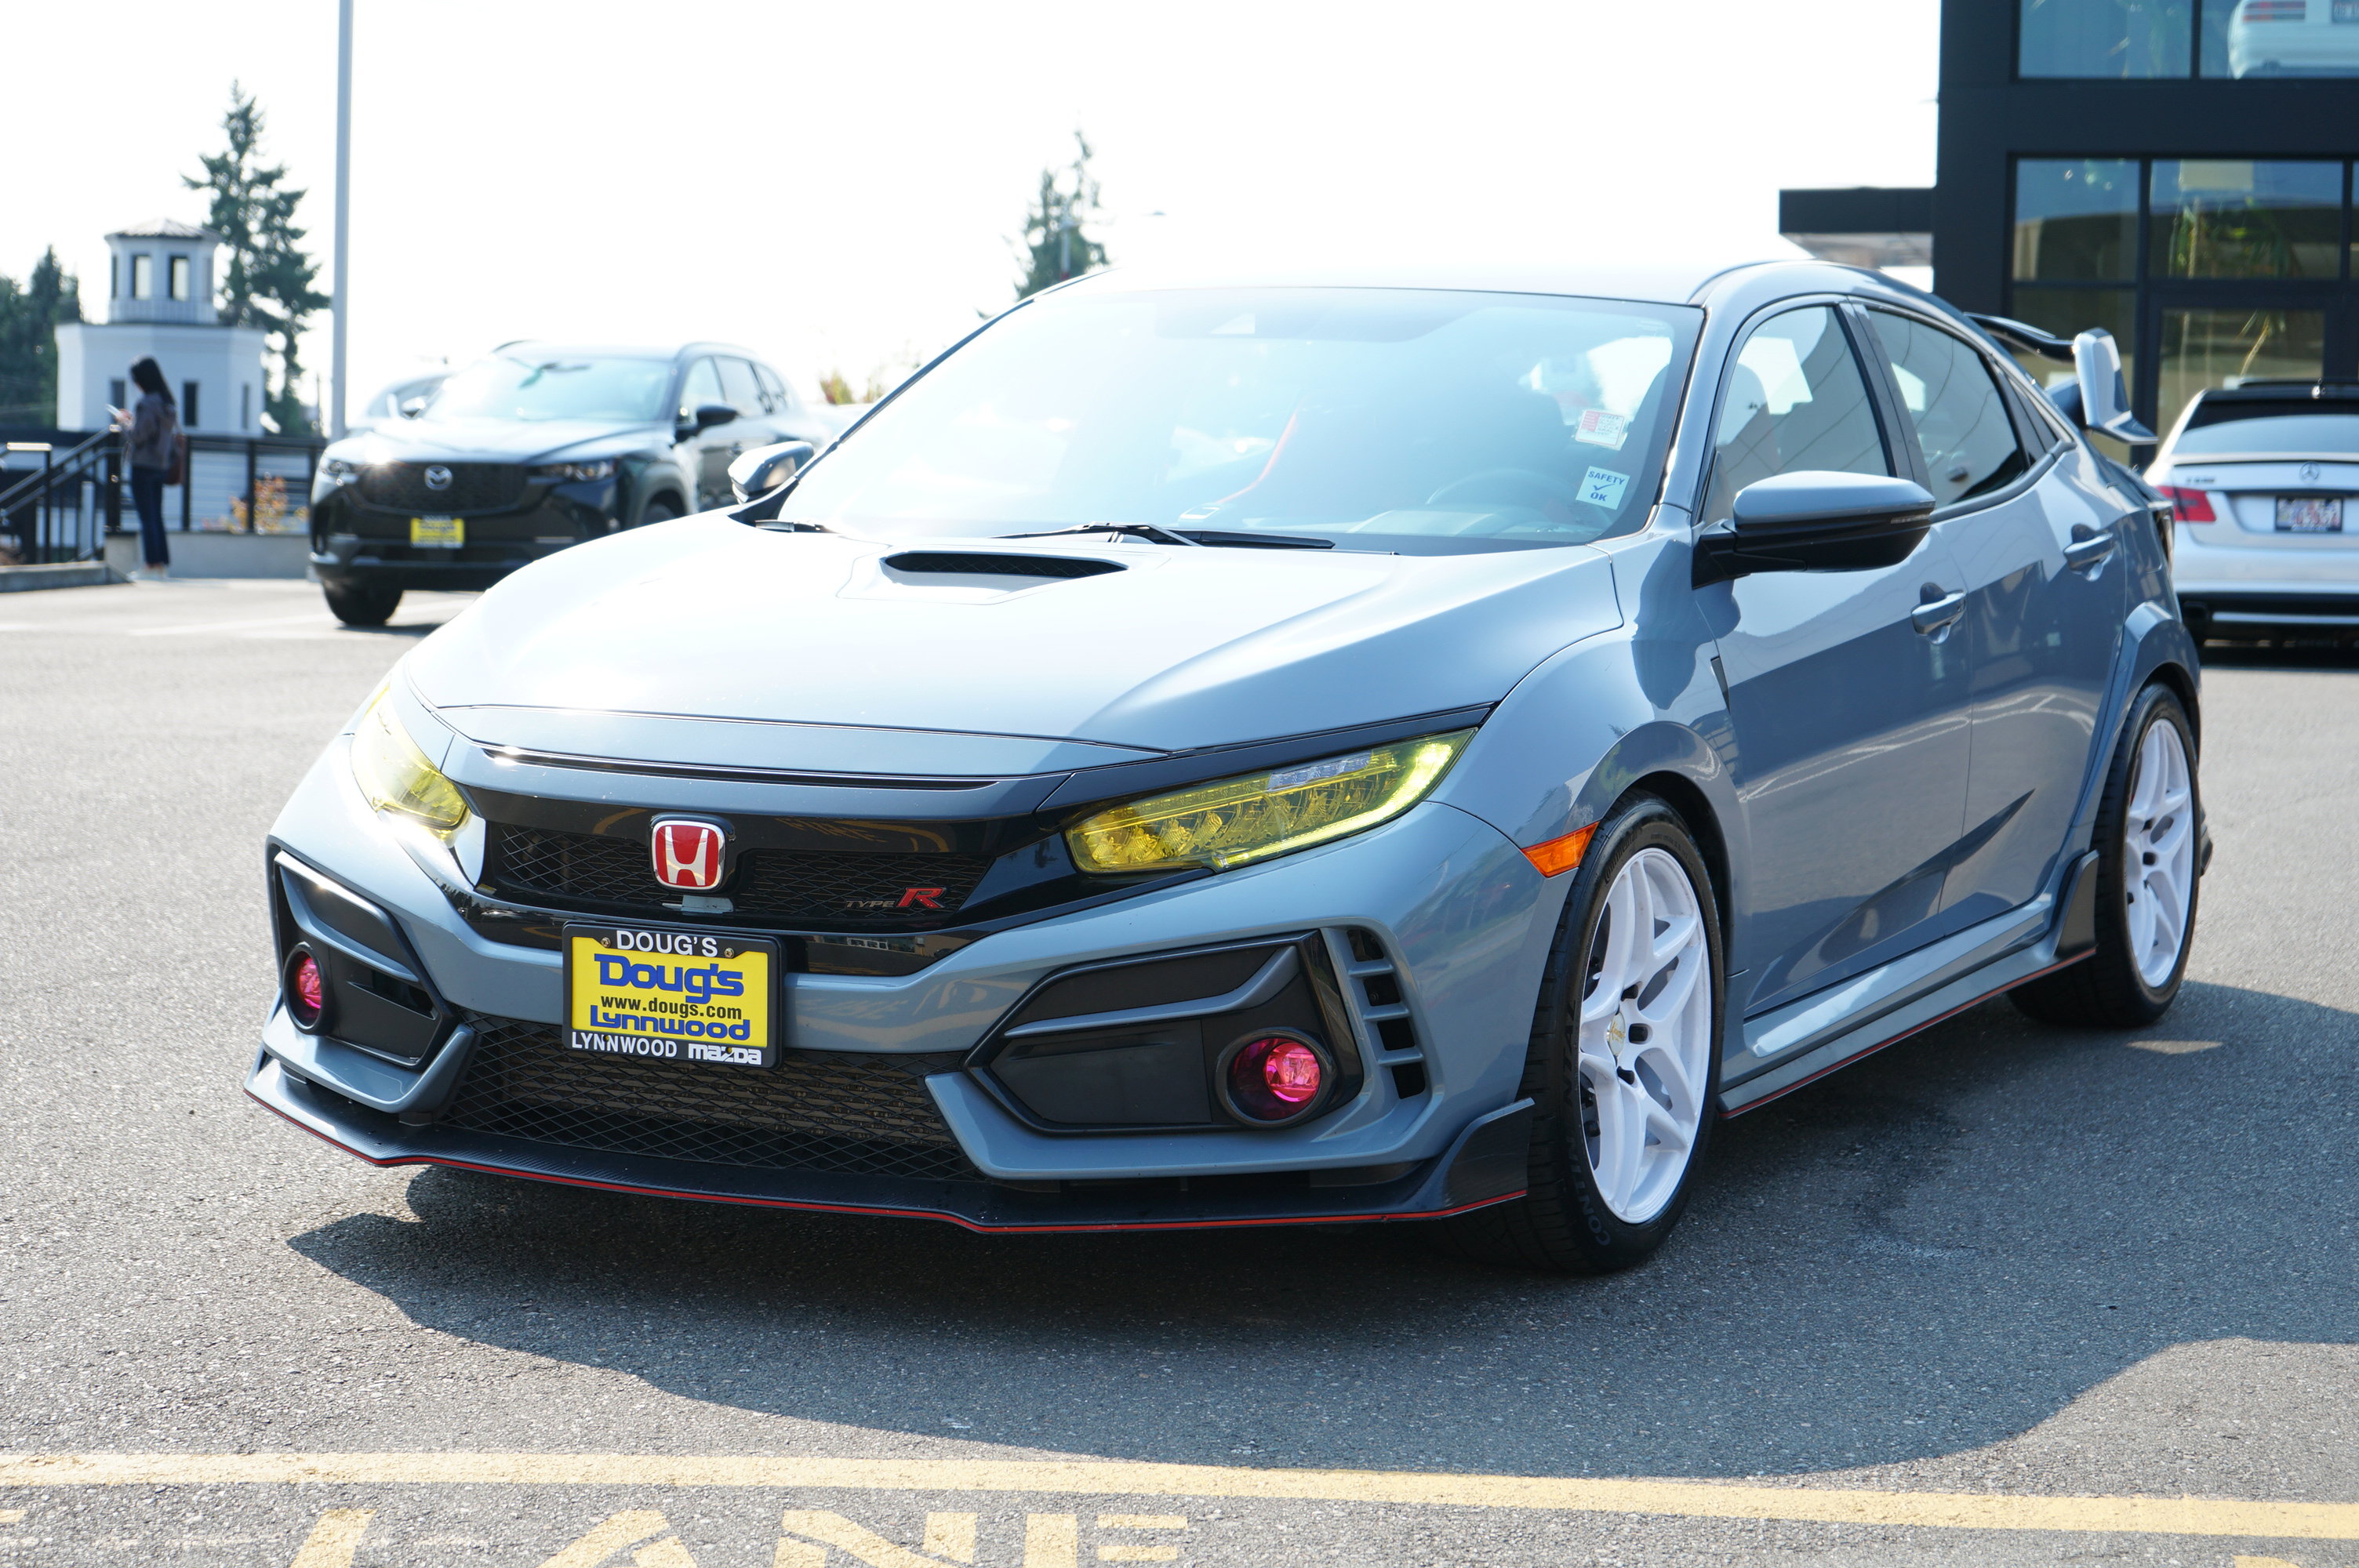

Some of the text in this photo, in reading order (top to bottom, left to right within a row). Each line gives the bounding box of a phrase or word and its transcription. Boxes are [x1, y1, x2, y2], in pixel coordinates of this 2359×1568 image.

[1588, 470, 1625, 485] SAFETY
[1590, 492, 1608, 502] OK
[896, 887, 946, 909] R
[616, 930, 718, 957] DOUG'S
[594, 953, 744, 1004] Doug's
[601, 996, 742, 1019] www.dougs.com
[590, 1005, 751, 1040] Lynnwood
[572, 1031, 678, 1058] LYNNWOOD
